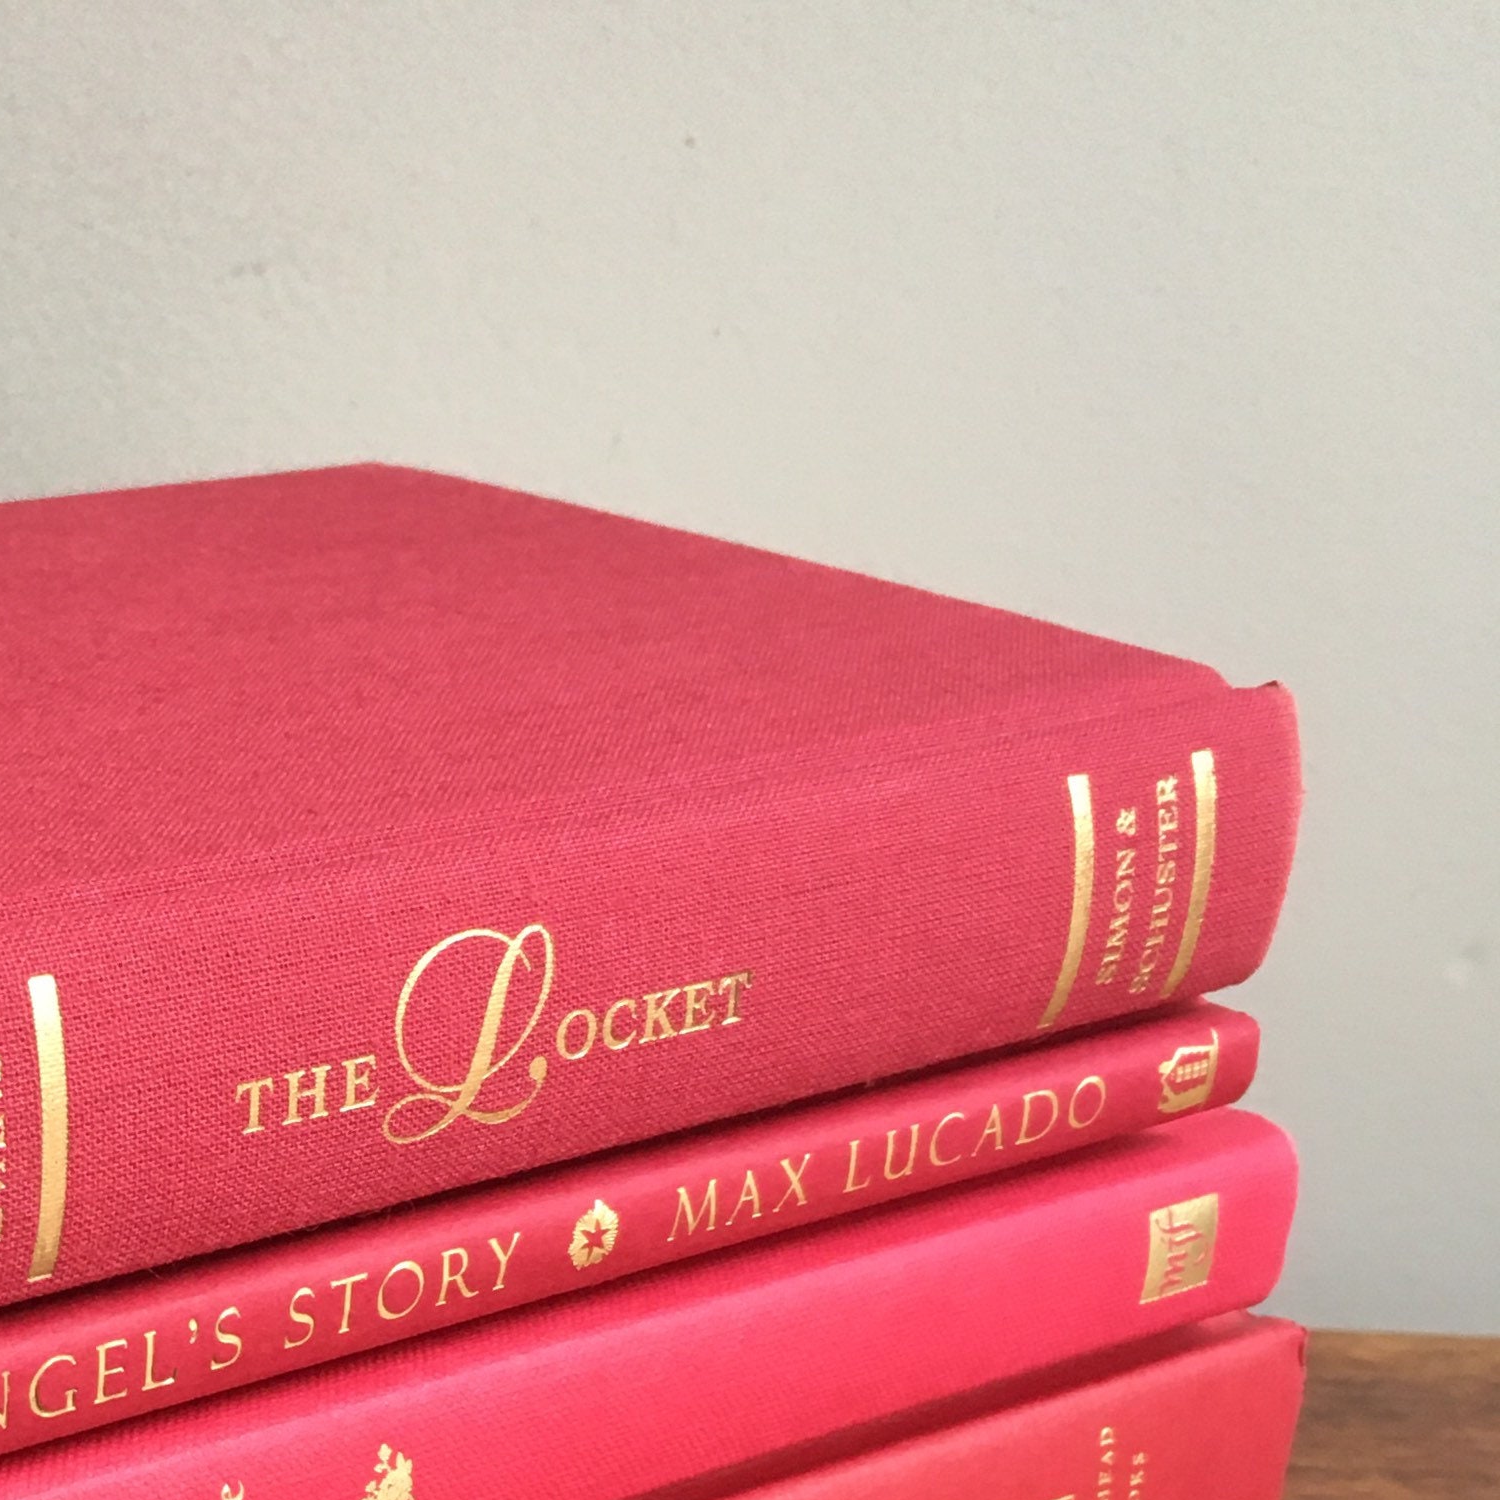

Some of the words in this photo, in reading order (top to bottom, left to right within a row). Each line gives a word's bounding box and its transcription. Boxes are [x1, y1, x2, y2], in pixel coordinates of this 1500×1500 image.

[1115, 806, 1137, 836] &
[1128, 775, 1179, 994] SCHUSTER
[1095, 849, 1136, 985] SIMON
[235, 1055, 380, 1135] THE
[284, 1231, 522, 1351] STORY
[666, 1153, 811, 1242] MAX
[842, 1075, 1107, 1194] LUCADO
